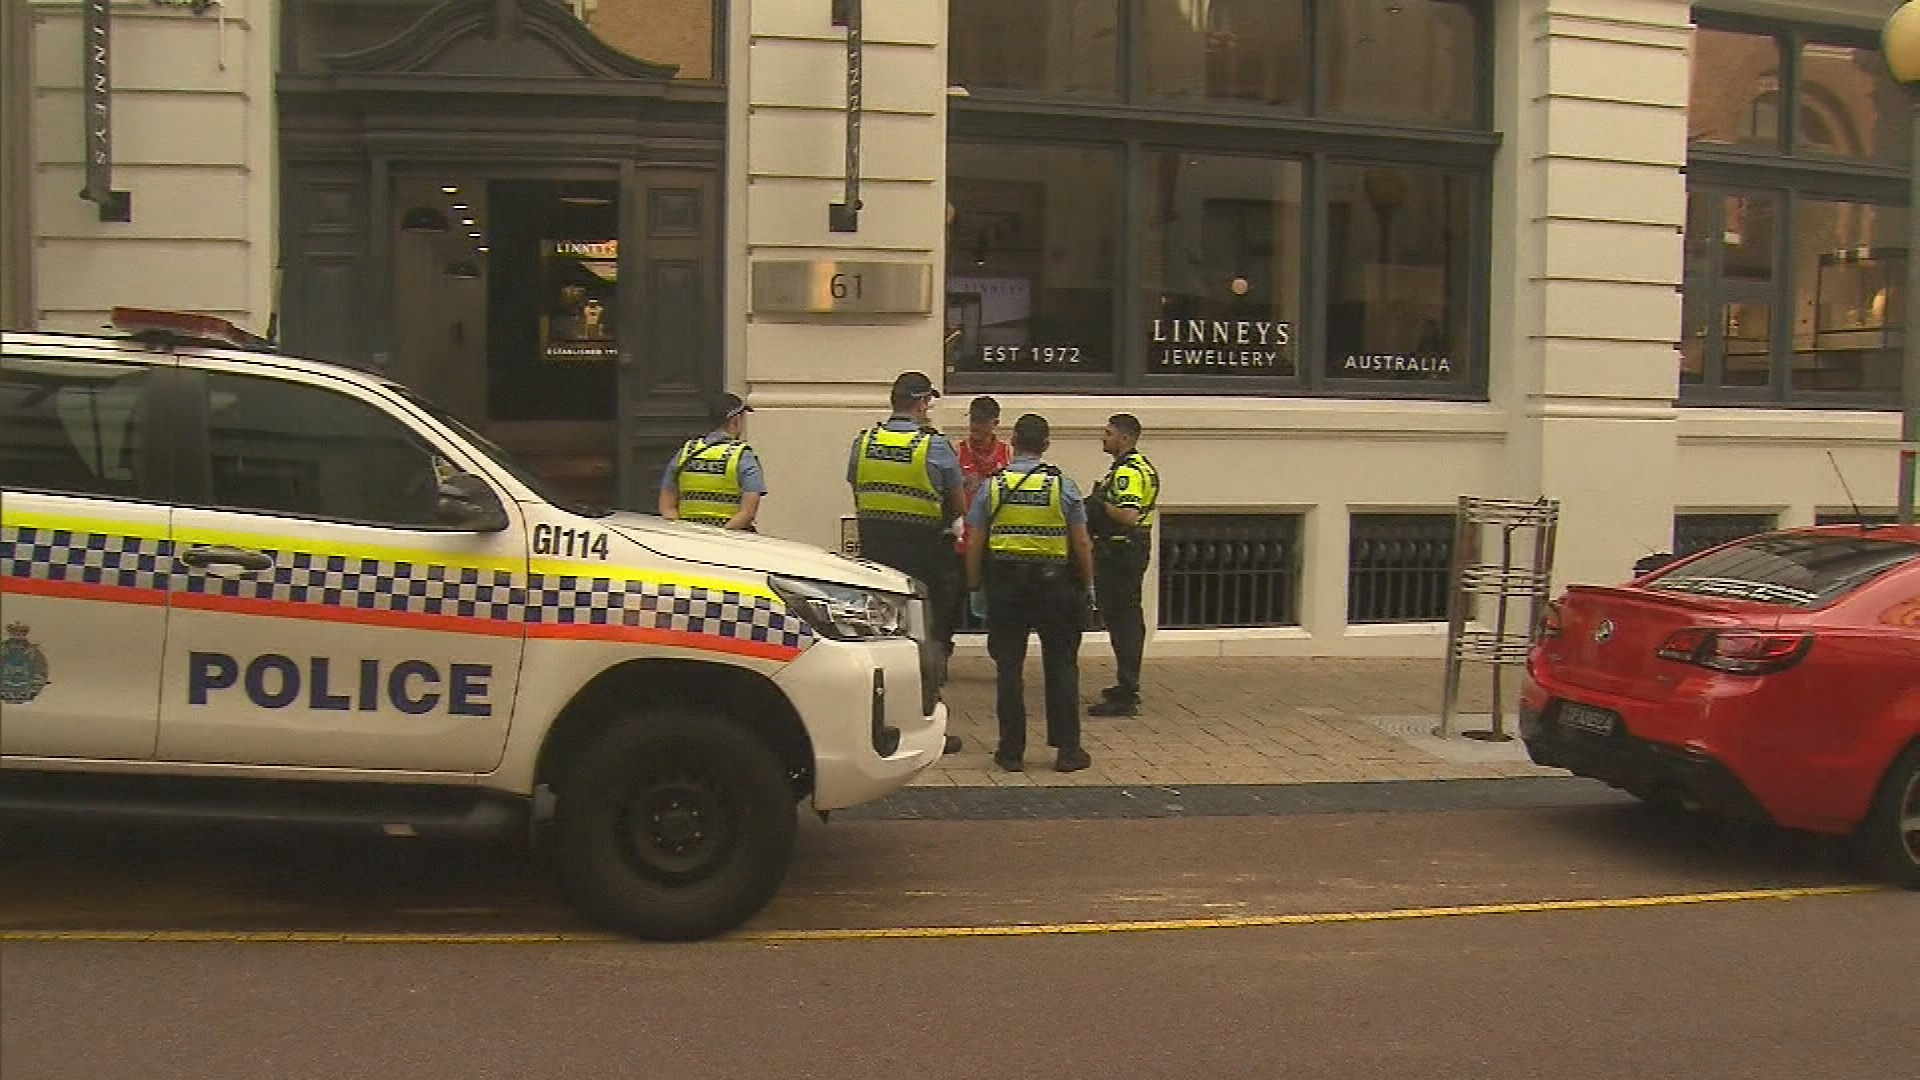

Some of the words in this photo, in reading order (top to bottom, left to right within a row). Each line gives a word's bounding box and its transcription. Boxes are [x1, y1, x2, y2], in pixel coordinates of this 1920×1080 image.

[830, 273, 862, 299] 61
[1153, 319, 1289, 345] LINNEYS
[983, 347, 1020, 363] EST
[1031, 347, 1081, 363] 1972
[1161, 349, 1276, 366] JEWELLERY
[1343, 355, 1450, 372] AUSTRALIA
[868, 446, 912, 461] POLICE
[533, 523, 608, 560] GI114
[188, 651, 492, 716] POLICE
